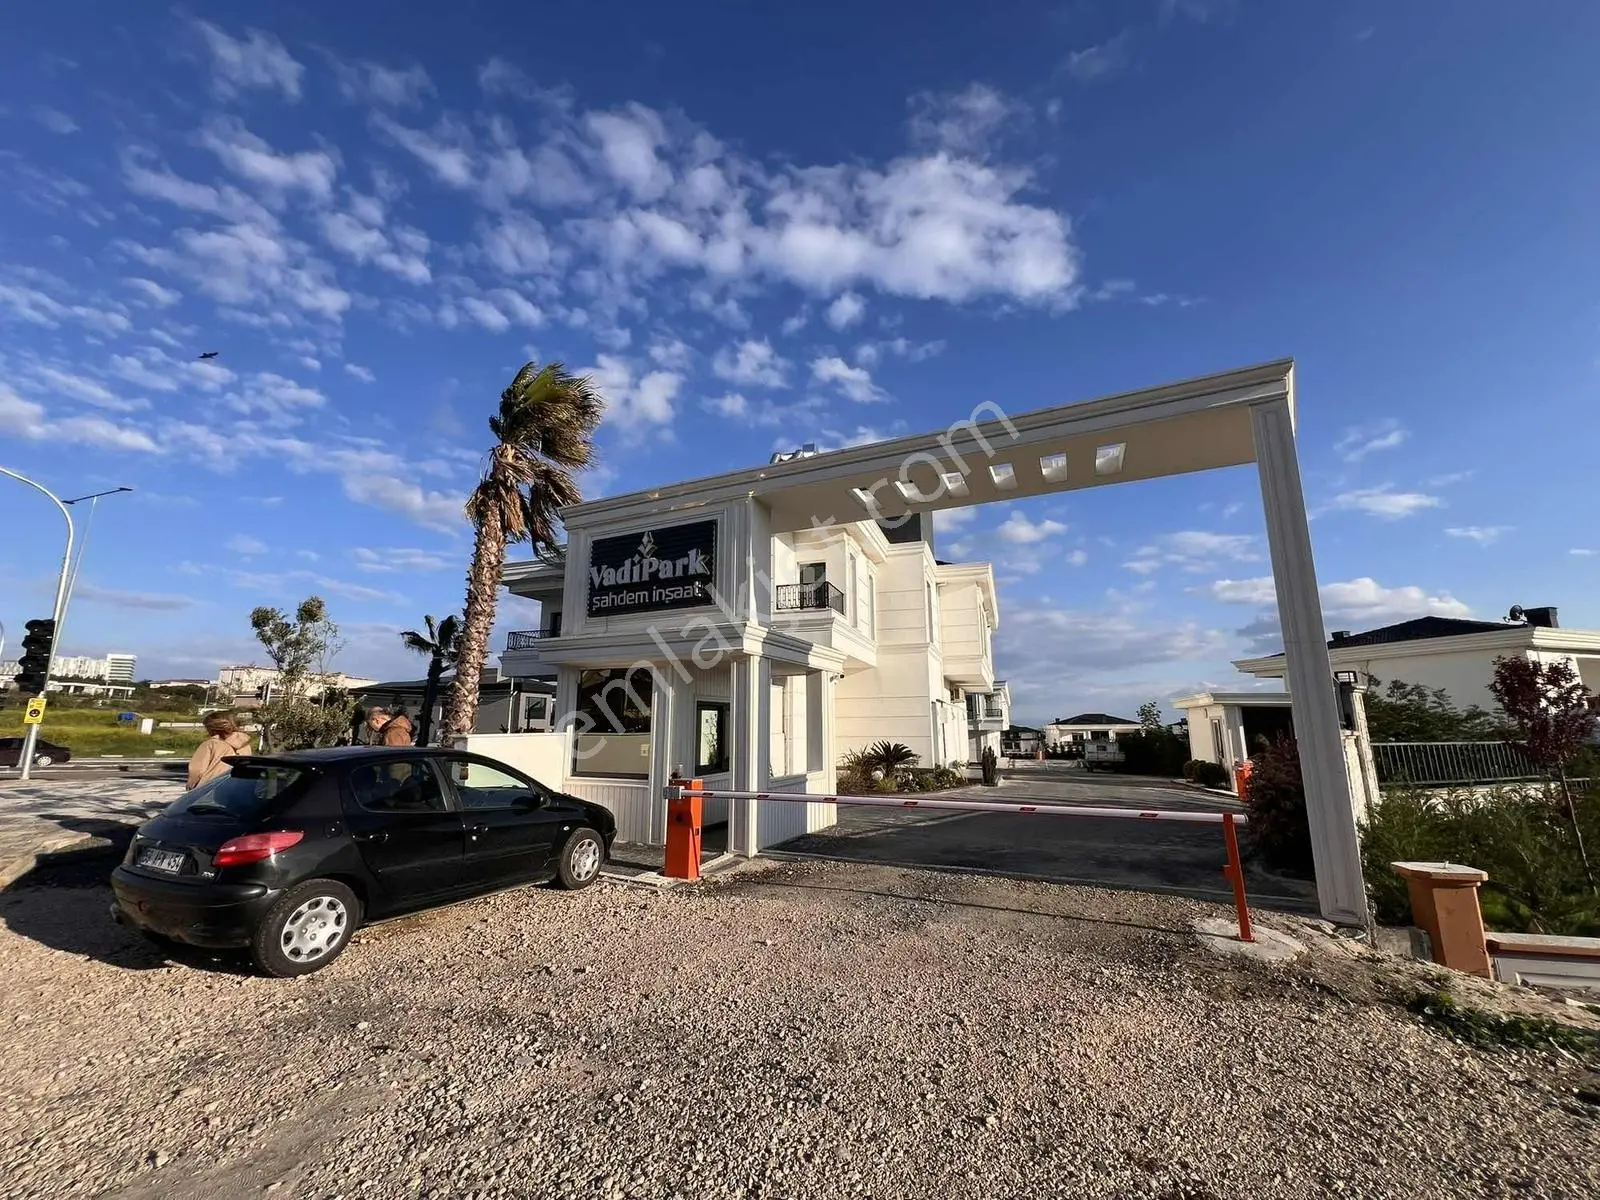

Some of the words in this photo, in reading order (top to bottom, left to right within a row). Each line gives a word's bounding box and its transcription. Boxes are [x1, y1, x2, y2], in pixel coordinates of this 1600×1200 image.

[590, 549, 710, 589] VadiPark
[593, 591, 649, 611] şahdem
[652, 581, 702, 604] inşaat
